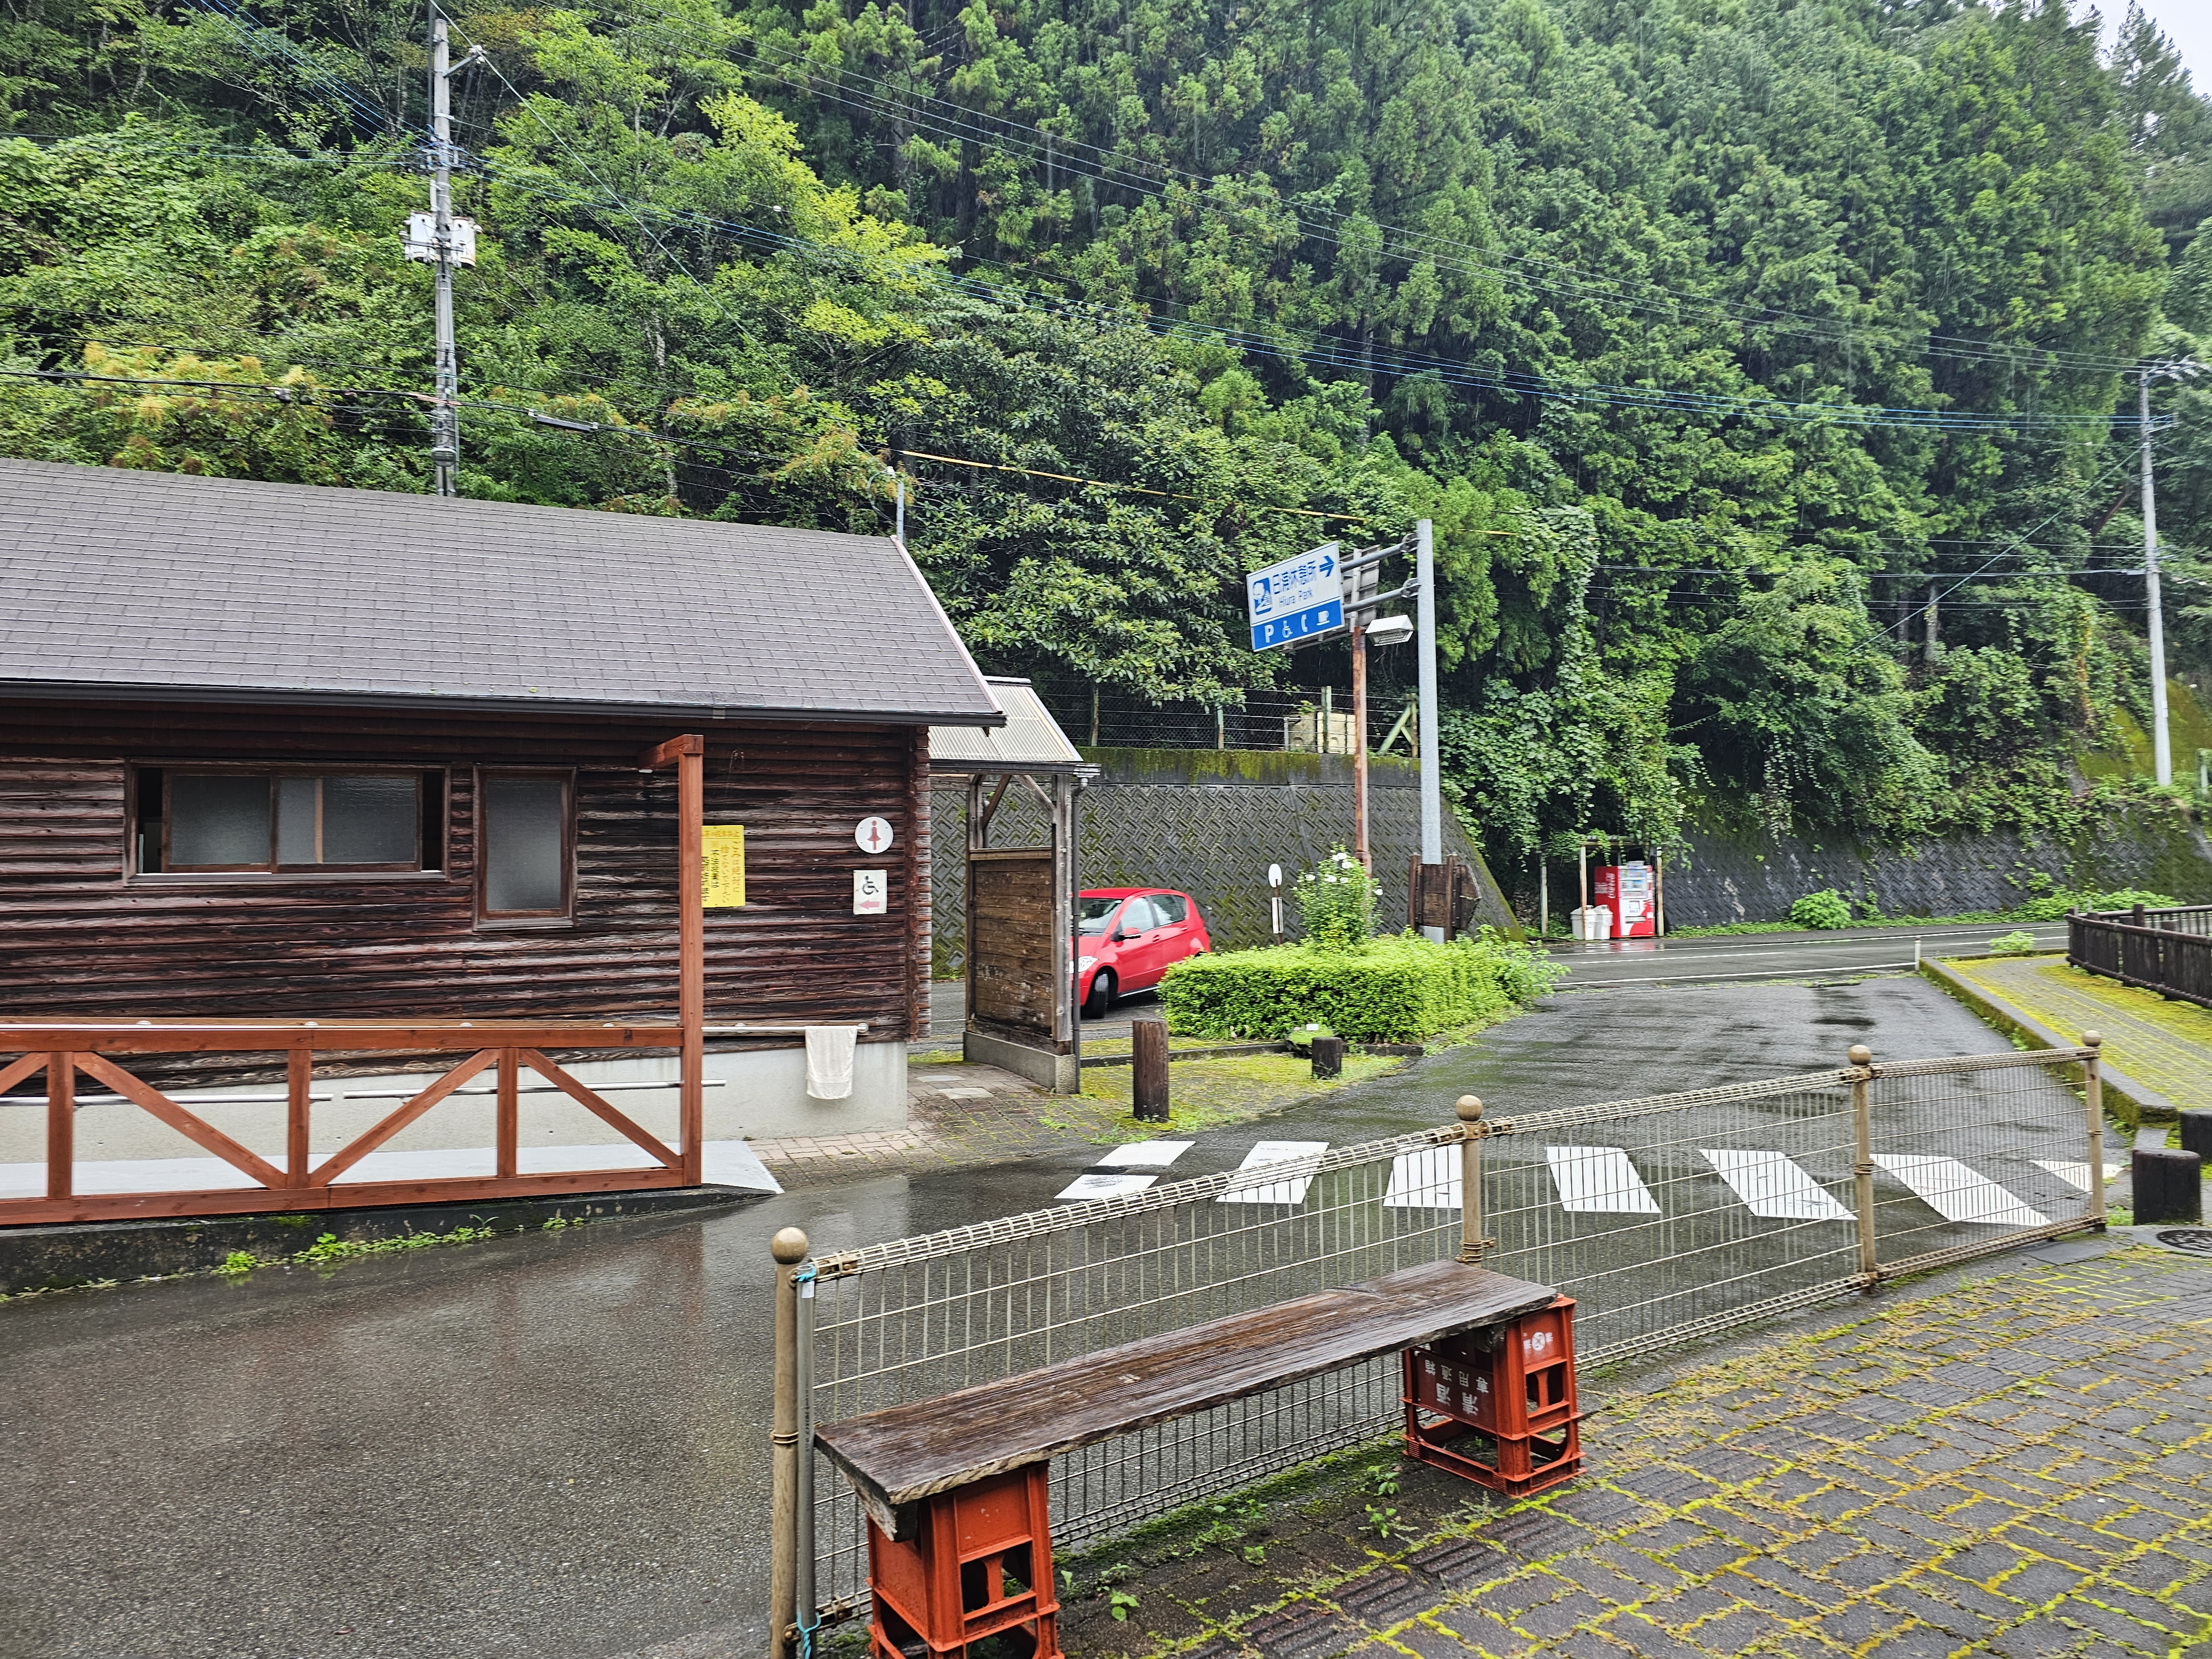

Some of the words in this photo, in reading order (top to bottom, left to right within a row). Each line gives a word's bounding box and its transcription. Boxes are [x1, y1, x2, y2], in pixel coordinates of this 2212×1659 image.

[1279, 595, 1296, 608] Hiura
[1298, 587, 1313, 601] Park
[1265, 624, 1275, 643] P
[1436, 1382, 1479, 1416] 清酒
